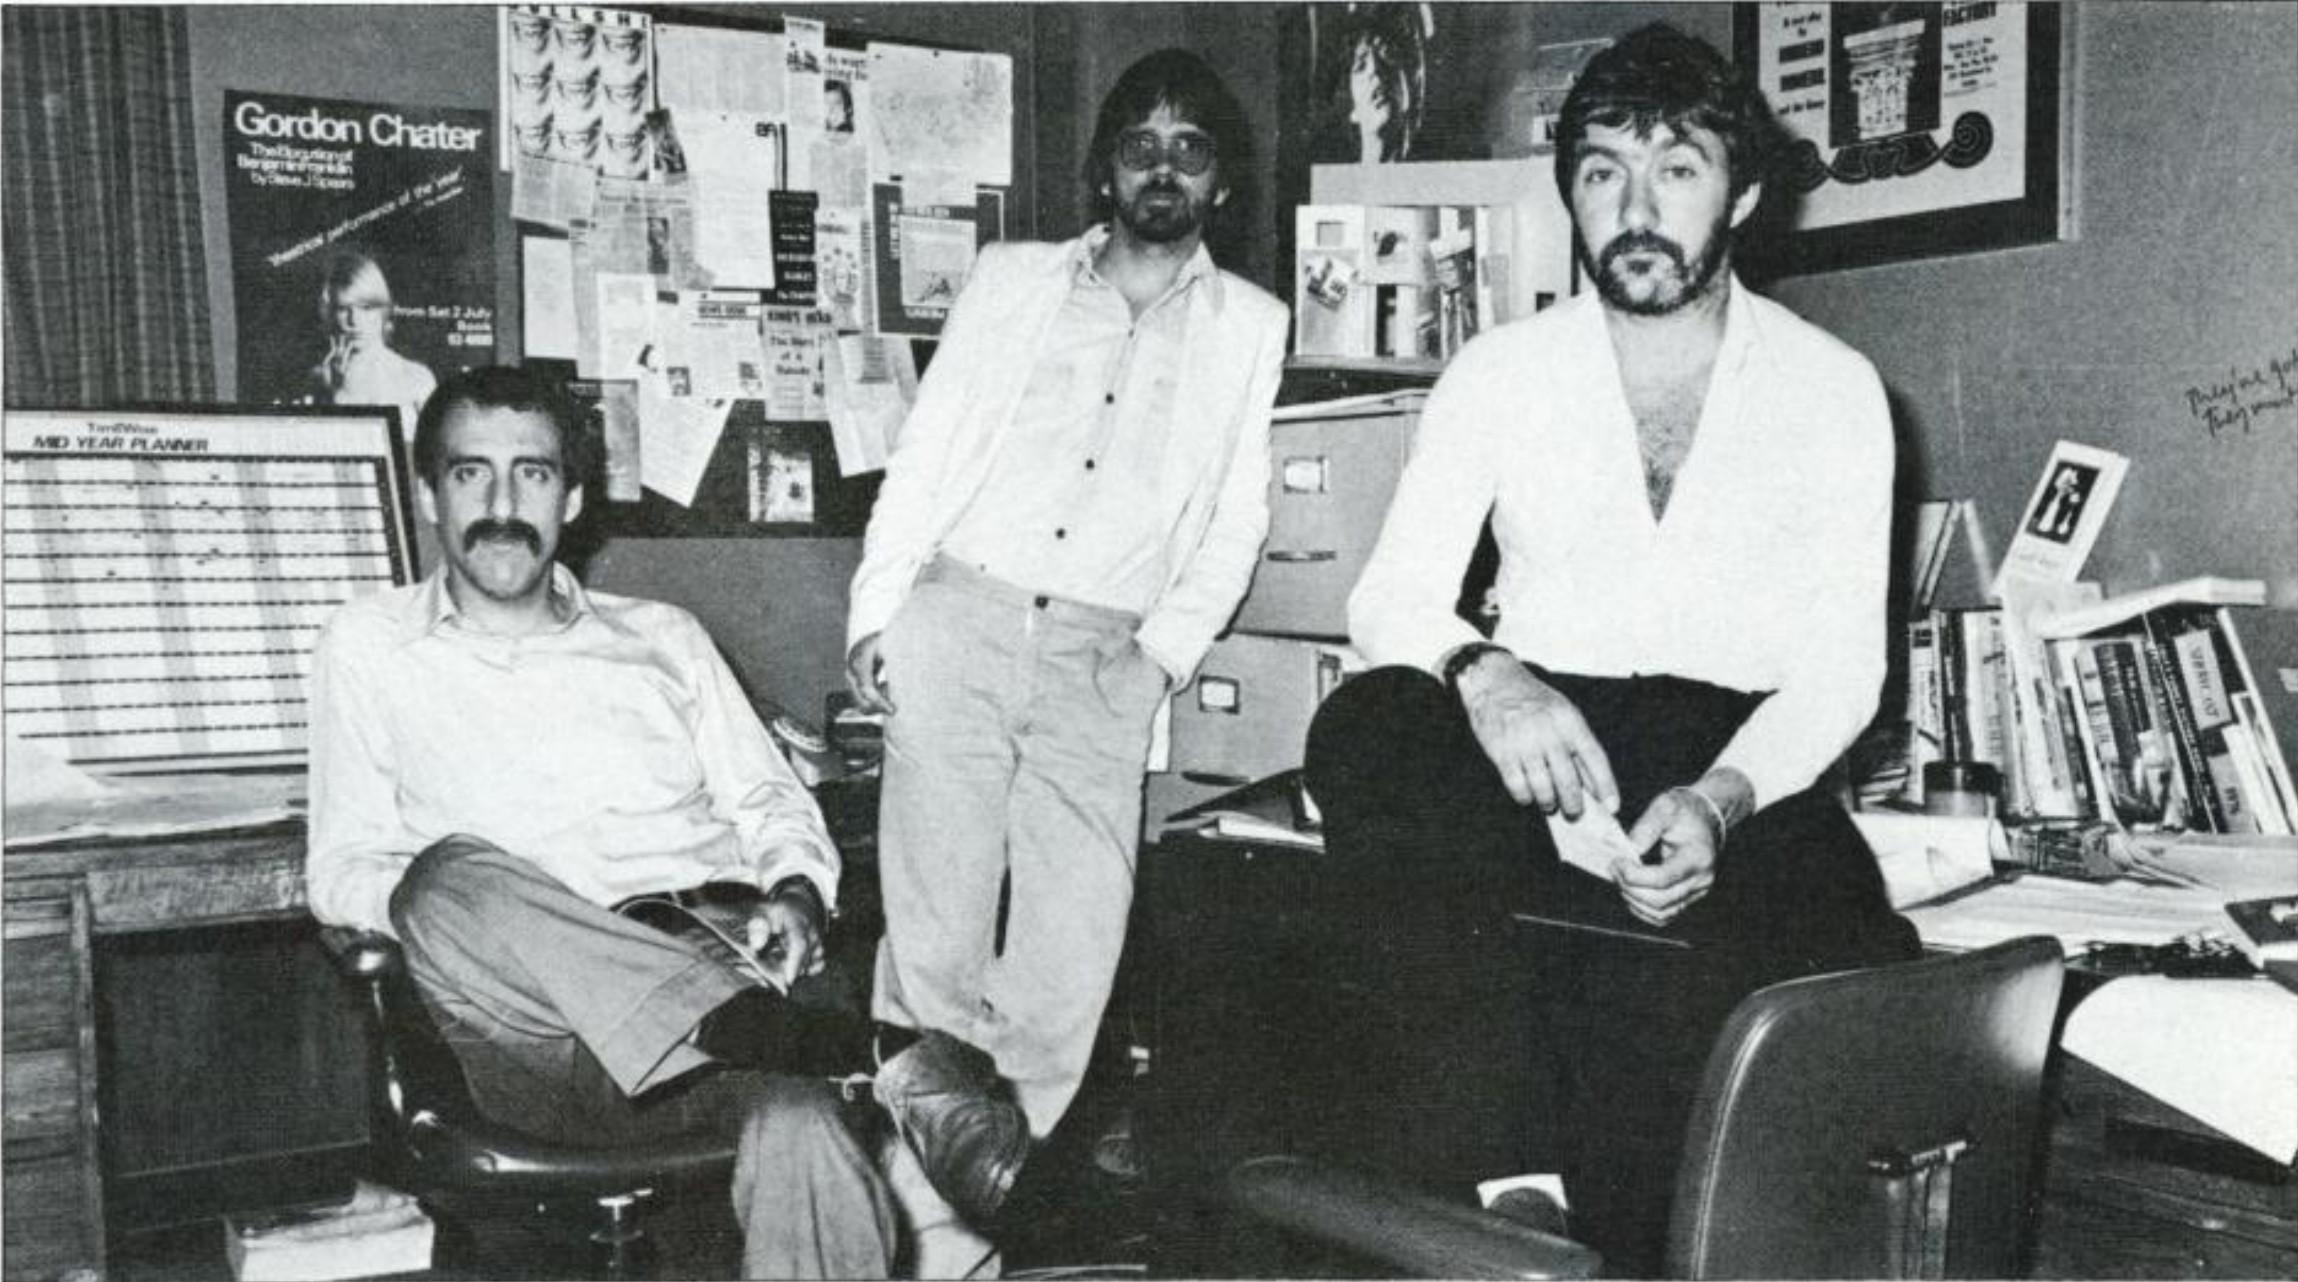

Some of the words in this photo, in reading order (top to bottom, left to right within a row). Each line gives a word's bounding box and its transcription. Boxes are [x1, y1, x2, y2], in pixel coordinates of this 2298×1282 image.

[234, 101, 363, 144] Gordon
[368, 112, 483, 151] Chater
[250, 142, 277, 156] The
[236, 153, 304, 174] Benjamin
[251, 171, 268, 187] by
[268, 174, 301, 186] Steve
[312, 174, 355, 190] Spears
[427, 304, 449, 318] Sat
[451, 304, 461, 319] 2
[463, 306, 491, 322] July
[456, 319, 491, 331] Book
[33, 435, 71, 449] MID
[76, 436, 125, 449] YEAR
[130, 438, 209, 452] PLANNER
